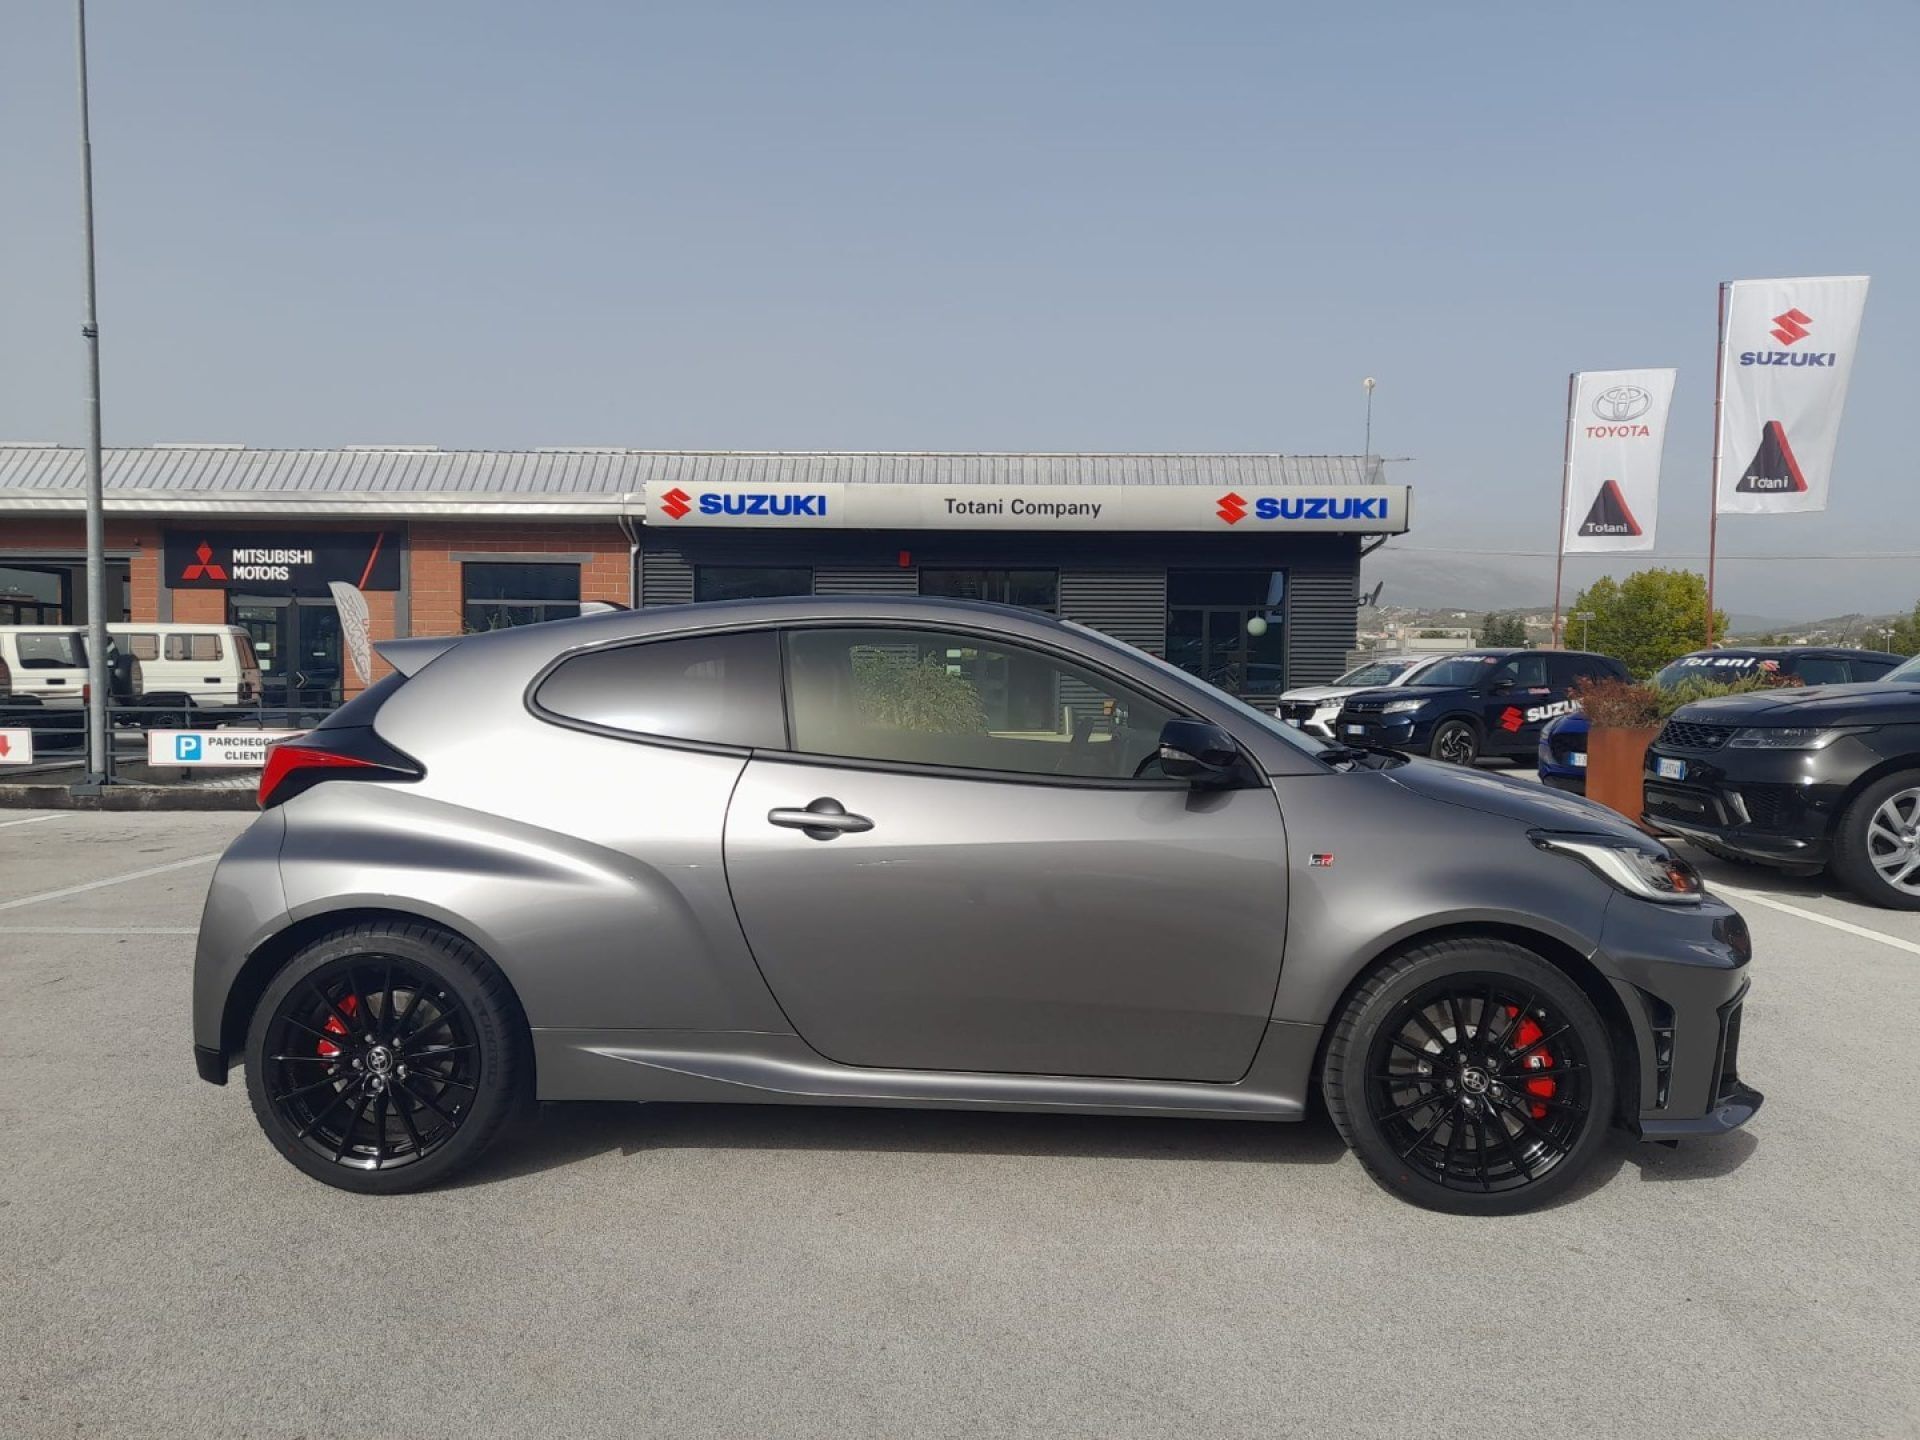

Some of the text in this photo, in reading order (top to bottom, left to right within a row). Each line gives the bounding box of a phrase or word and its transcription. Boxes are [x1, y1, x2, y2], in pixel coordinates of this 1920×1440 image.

[1740, 352, 1836, 367] SUZUKI
[1586, 425, 1650, 438] TOYOTA
[700, 493, 826, 516] SUZUKI
[944, 498, 1102, 519] Totani Company
[1255, 498, 1388, 519] SUZUKI
[1587, 523, 1628, 533] Totani
[232, 549, 313, 564] MITSUBISHI
[232, 565, 289, 580] MOTORS
[1527, 699, 1585, 722] SUZUK
[180, 737, 197, 758] P
